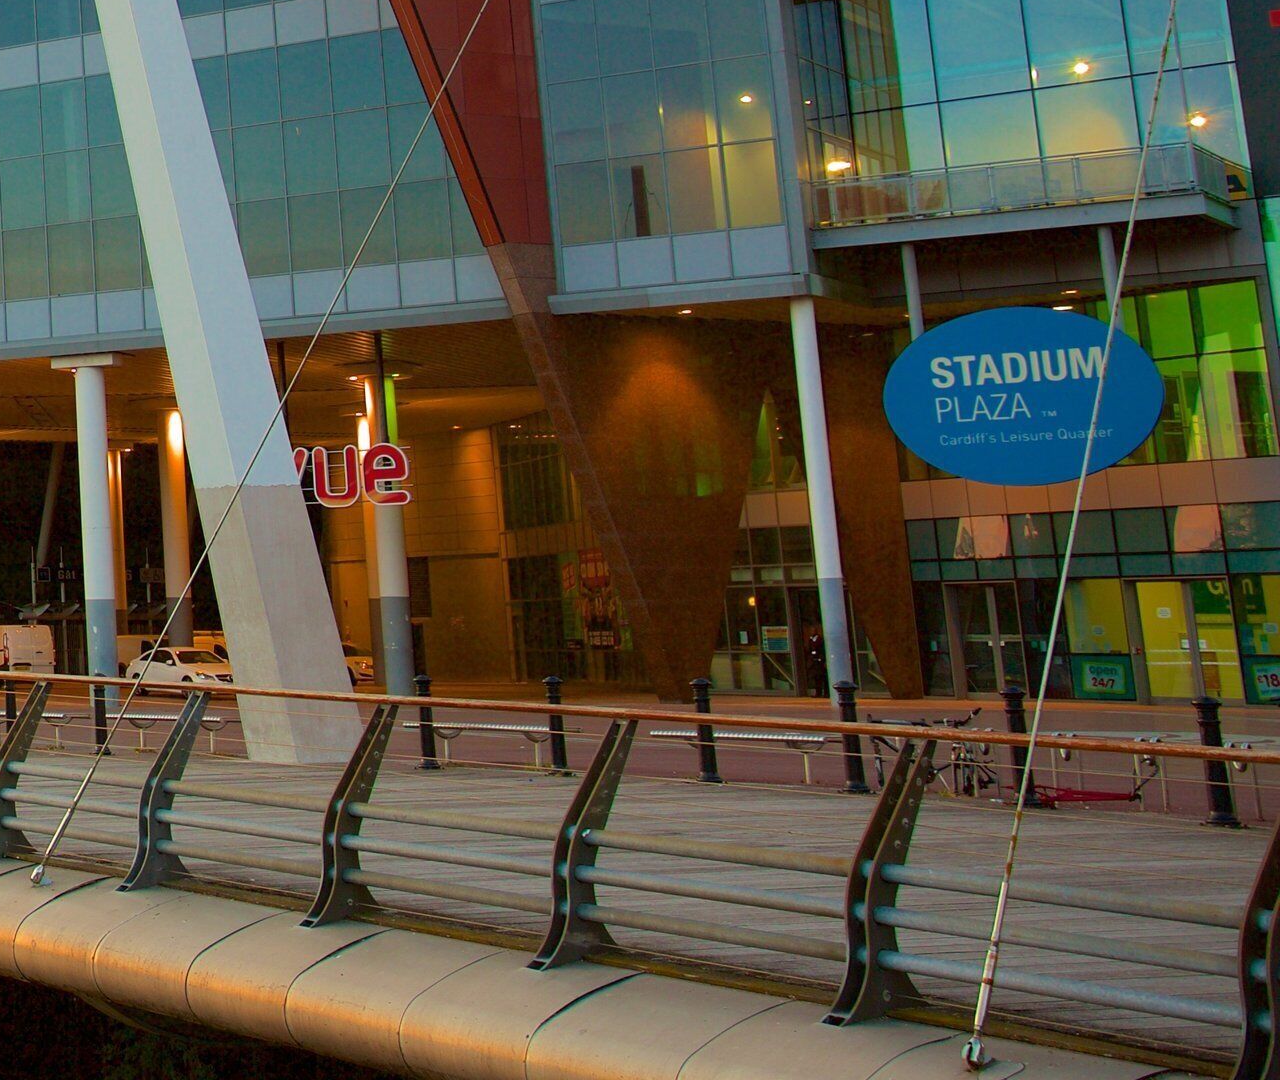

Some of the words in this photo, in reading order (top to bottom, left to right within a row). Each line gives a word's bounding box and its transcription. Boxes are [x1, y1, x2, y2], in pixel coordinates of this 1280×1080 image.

[930, 346, 1104, 388] STADIUM
[935, 392, 1031, 423] PLAZA
[940, 432, 997, 446] Cardiff's
[1001, 430, 1054, 443] Leisure
[1091, 676, 1115, 688] 24/7
